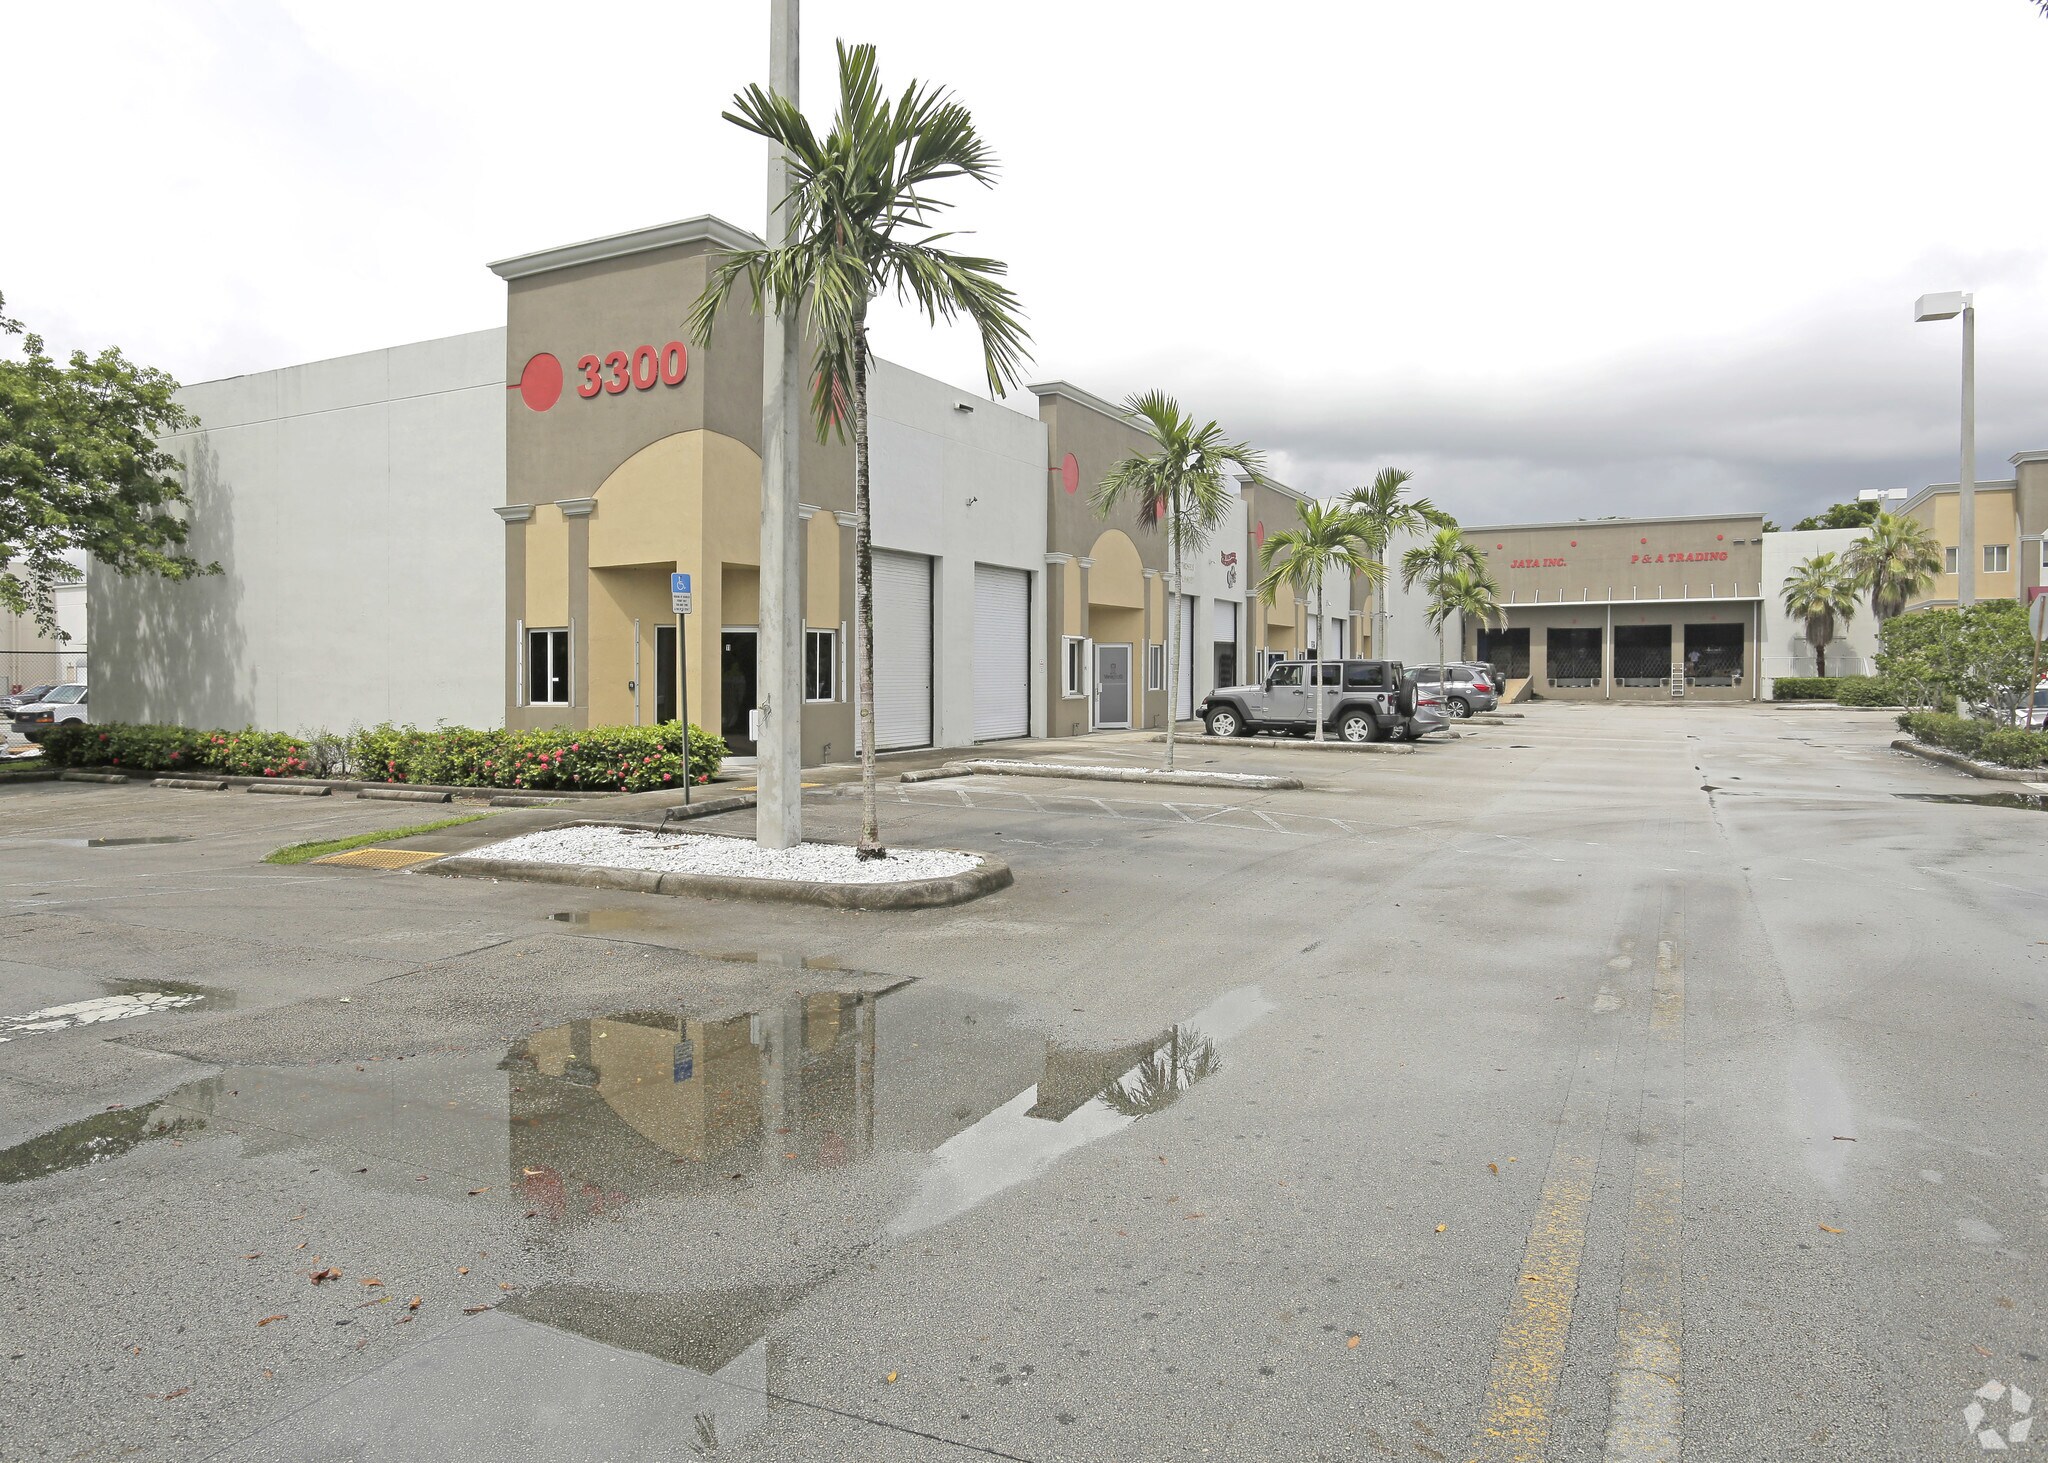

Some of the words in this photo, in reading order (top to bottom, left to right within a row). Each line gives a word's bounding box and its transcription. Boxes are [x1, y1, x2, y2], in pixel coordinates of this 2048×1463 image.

[576, 340, 688, 398] 3300
[1510, 559, 1540, 568] JAYA
[1543, 558, 1567, 567] INC.
[1631, 554, 1639, 564] P
[1642, 554, 1652, 563] &
[1655, 553, 1664, 563] A
[1668, 552, 1728, 562] TRADING
